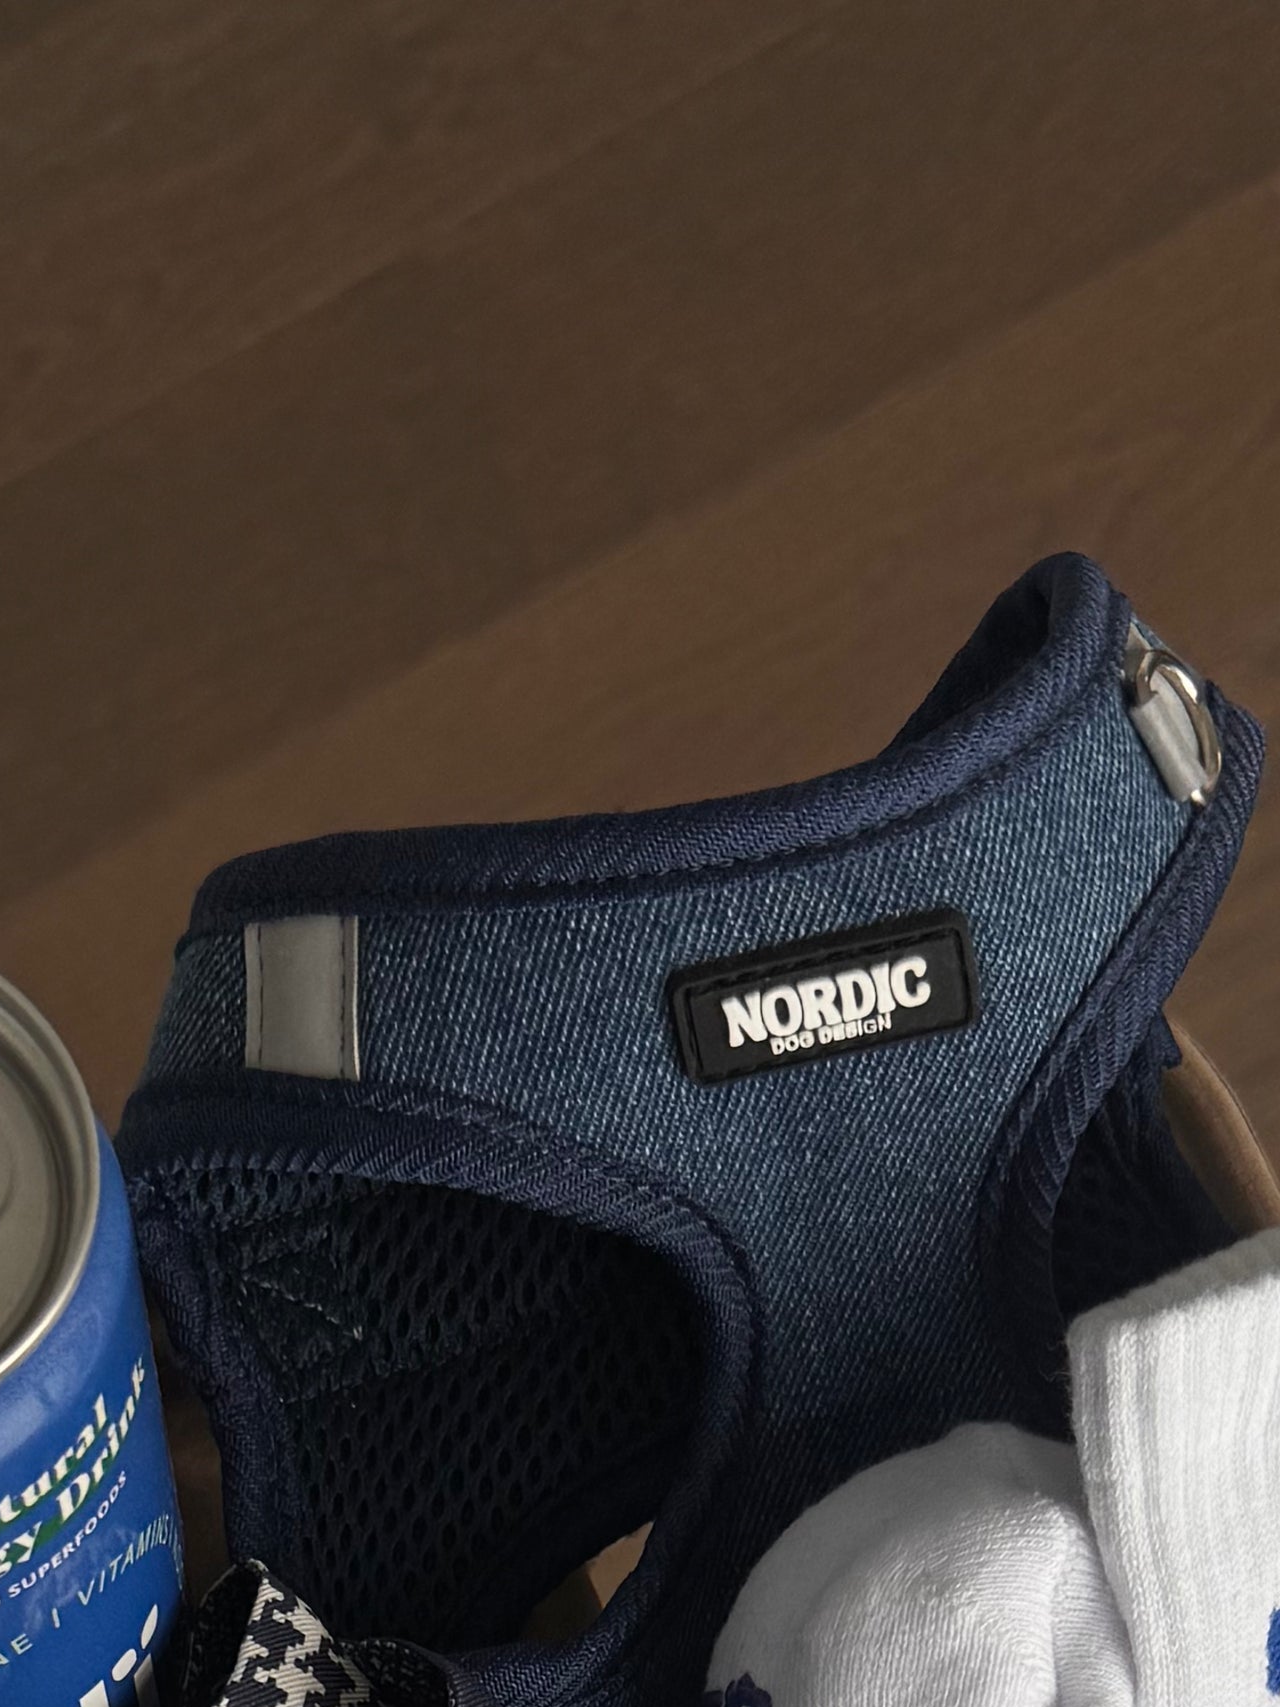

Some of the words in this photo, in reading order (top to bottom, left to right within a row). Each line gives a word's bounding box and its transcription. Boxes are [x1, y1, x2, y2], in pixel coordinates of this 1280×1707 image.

[721, 956, 932, 1047] NORDIC
[55, 1356, 147, 1524] Drink
[8, 1470, 128, 1600] SUPERFOODS
[76, 1512, 170, 1607] VITAMINS
